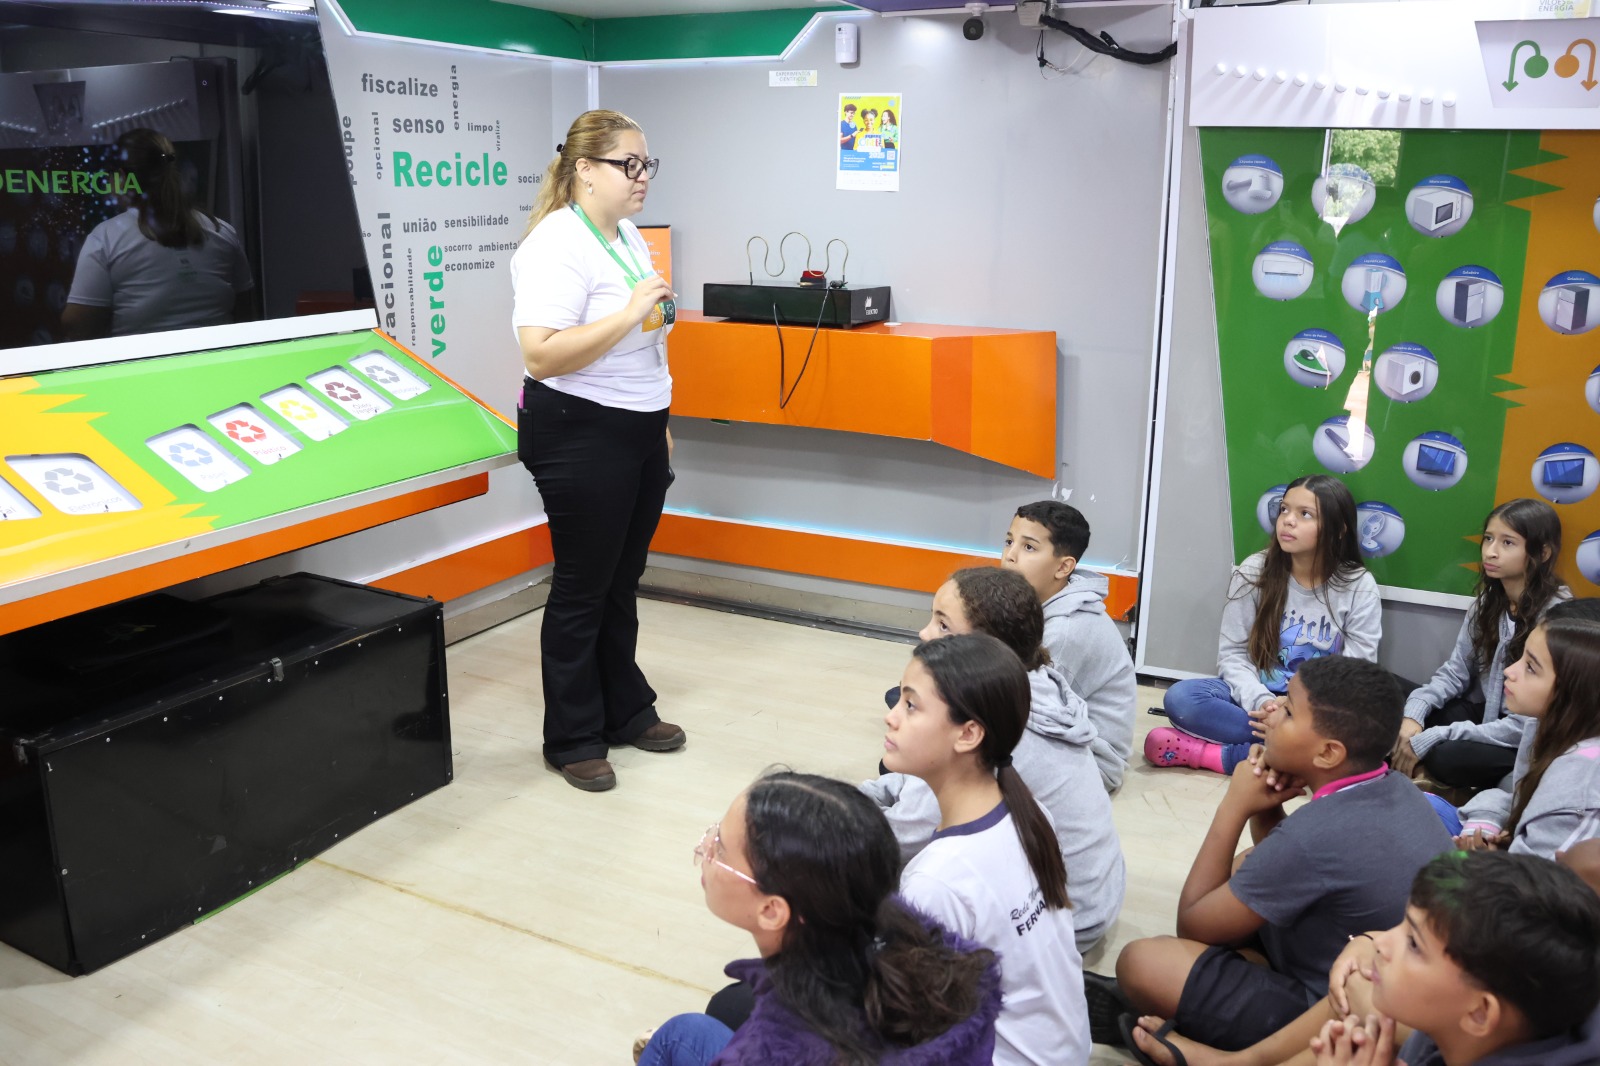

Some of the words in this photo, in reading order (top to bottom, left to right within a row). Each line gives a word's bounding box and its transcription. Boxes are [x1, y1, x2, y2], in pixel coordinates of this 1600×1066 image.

[1538, 4, 1574, 12] ENERGIA
[361, 73, 438, 97] fiscalize
[450, 65, 460, 130] energia
[392, 117, 445, 134] senso
[467, 122, 494, 134] limpo
[371, 112, 383, 180] opcional
[392, 151, 508, 187] Recicle
[402, 218, 437, 233] união
[444, 214, 509, 229] sensibilidade
[444, 243, 473, 252] socorro
[444, 259, 495, 272] economize
[407, 248, 416, 346] responsabilidade
[423, 245, 446, 358] verde
[1280, 609, 1332, 642] titch
[1009, 901, 1029, 921] Rede
